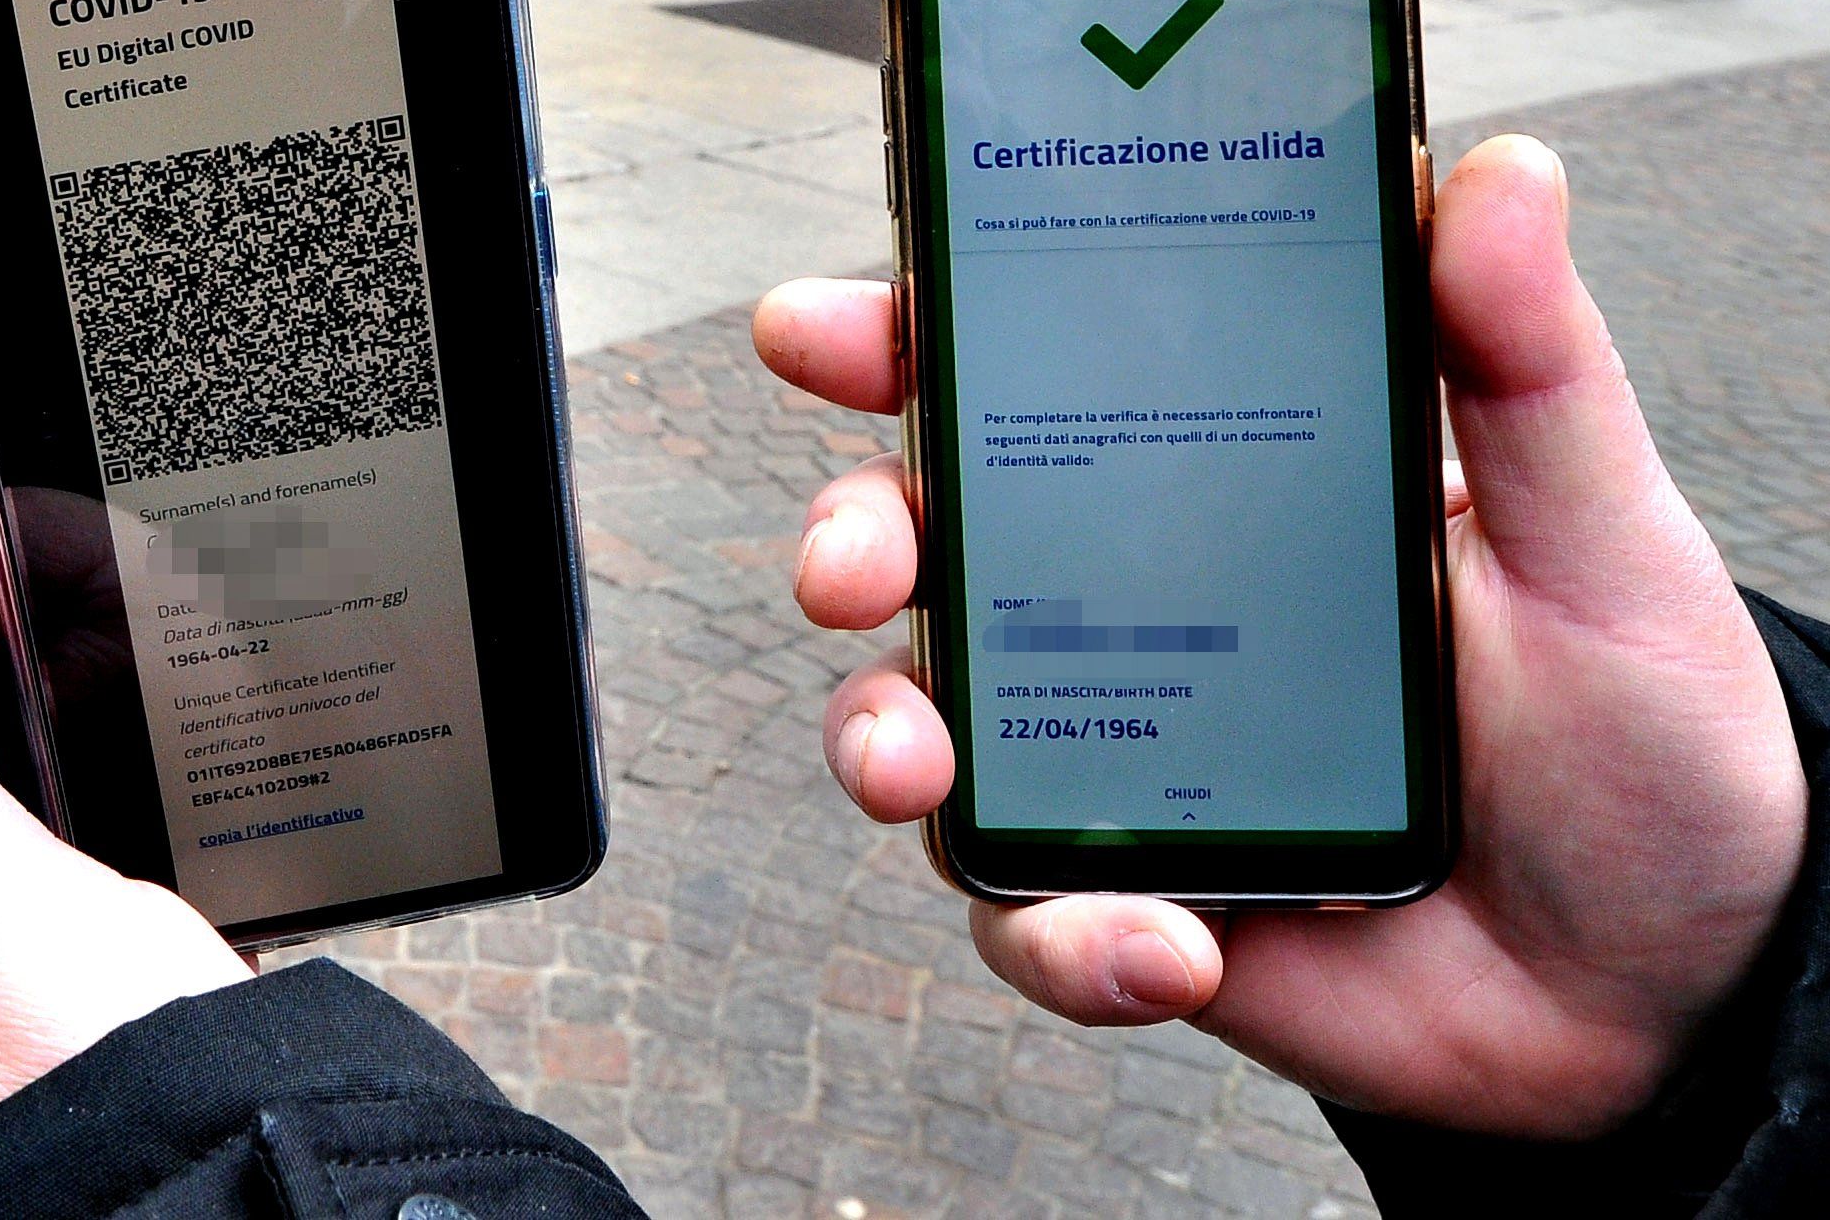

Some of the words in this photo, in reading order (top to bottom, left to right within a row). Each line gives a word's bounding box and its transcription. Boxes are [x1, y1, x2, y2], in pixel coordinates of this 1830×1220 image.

[57, 50, 90, 71] EU
[97, 32, 175, 65] Digital
[180, 19, 254, 50] COVID
[65, 73, 188, 109] Certificate
[973, 136, 1209, 170] Certificazione
[1219, 130, 1326, 161] valida
[975, 218, 1005, 230] Cosa
[1009, 217, 1019, 229] si
[1022, 216, 1047, 231] può
[1050, 215, 1076, 228] fare
[1079, 216, 1102, 228] con
[1105, 214, 1117, 226] la
[1120, 212, 1208, 226] certificazione
[1210, 210, 1248, 223] verde
[1251, 209, 1316, 222] COVID-19
[984, 413, 1007, 425] Per
[1010, 412, 1083, 427] completare
[1085, 411, 1098, 423] la
[1100, 410, 1148, 423] verifica
[1151, 409, 1160, 422] è
[1162, 409, 1233, 422] necessario
[1236, 408, 1314, 421] confrontare
[985, 433, 1041, 449] seguenti
[1044, 433, 1070, 446] dati
[1072, 432, 1138, 448] anagrafici
[1140, 433, 1163, 444] con
[1166, 431, 1202, 447] quelli
[1205, 430, 1218, 443] di
[1221, 431, 1238, 443] un
[1241, 429, 1316, 443] documento
[986, 454, 1048, 467] d'identità
[1051, 454, 1095, 467] valido:
[139, 493, 236, 524] Surname(s)
[240, 487, 272, 506] and
[275, 468, 377, 500] forename(s)
[164, 628, 202, 645] Data
[207, 620, 221, 638] di
[167, 639, 270, 670] 1964-04-22
[174, 691, 232, 711] Unique
[235, 673, 319, 699] Certificate
[323, 660, 397, 684] Identifier
[997, 686, 1031, 698] DATA
[1034, 686, 1048, 698] DI
[1051, 686, 1155, 698] NASCITA/BIRTH
[1159, 686, 1194, 698] DATE
[179, 706, 285, 735] Identificativo
[289, 693, 351, 716] univoco
[355, 685, 381, 704] del
[999, 718, 1159, 740] 22/04/1964
[184, 734, 266, 760] certificato
[1164, 787, 1212, 800] CHIUDI
[198, 828, 243, 848] copia
